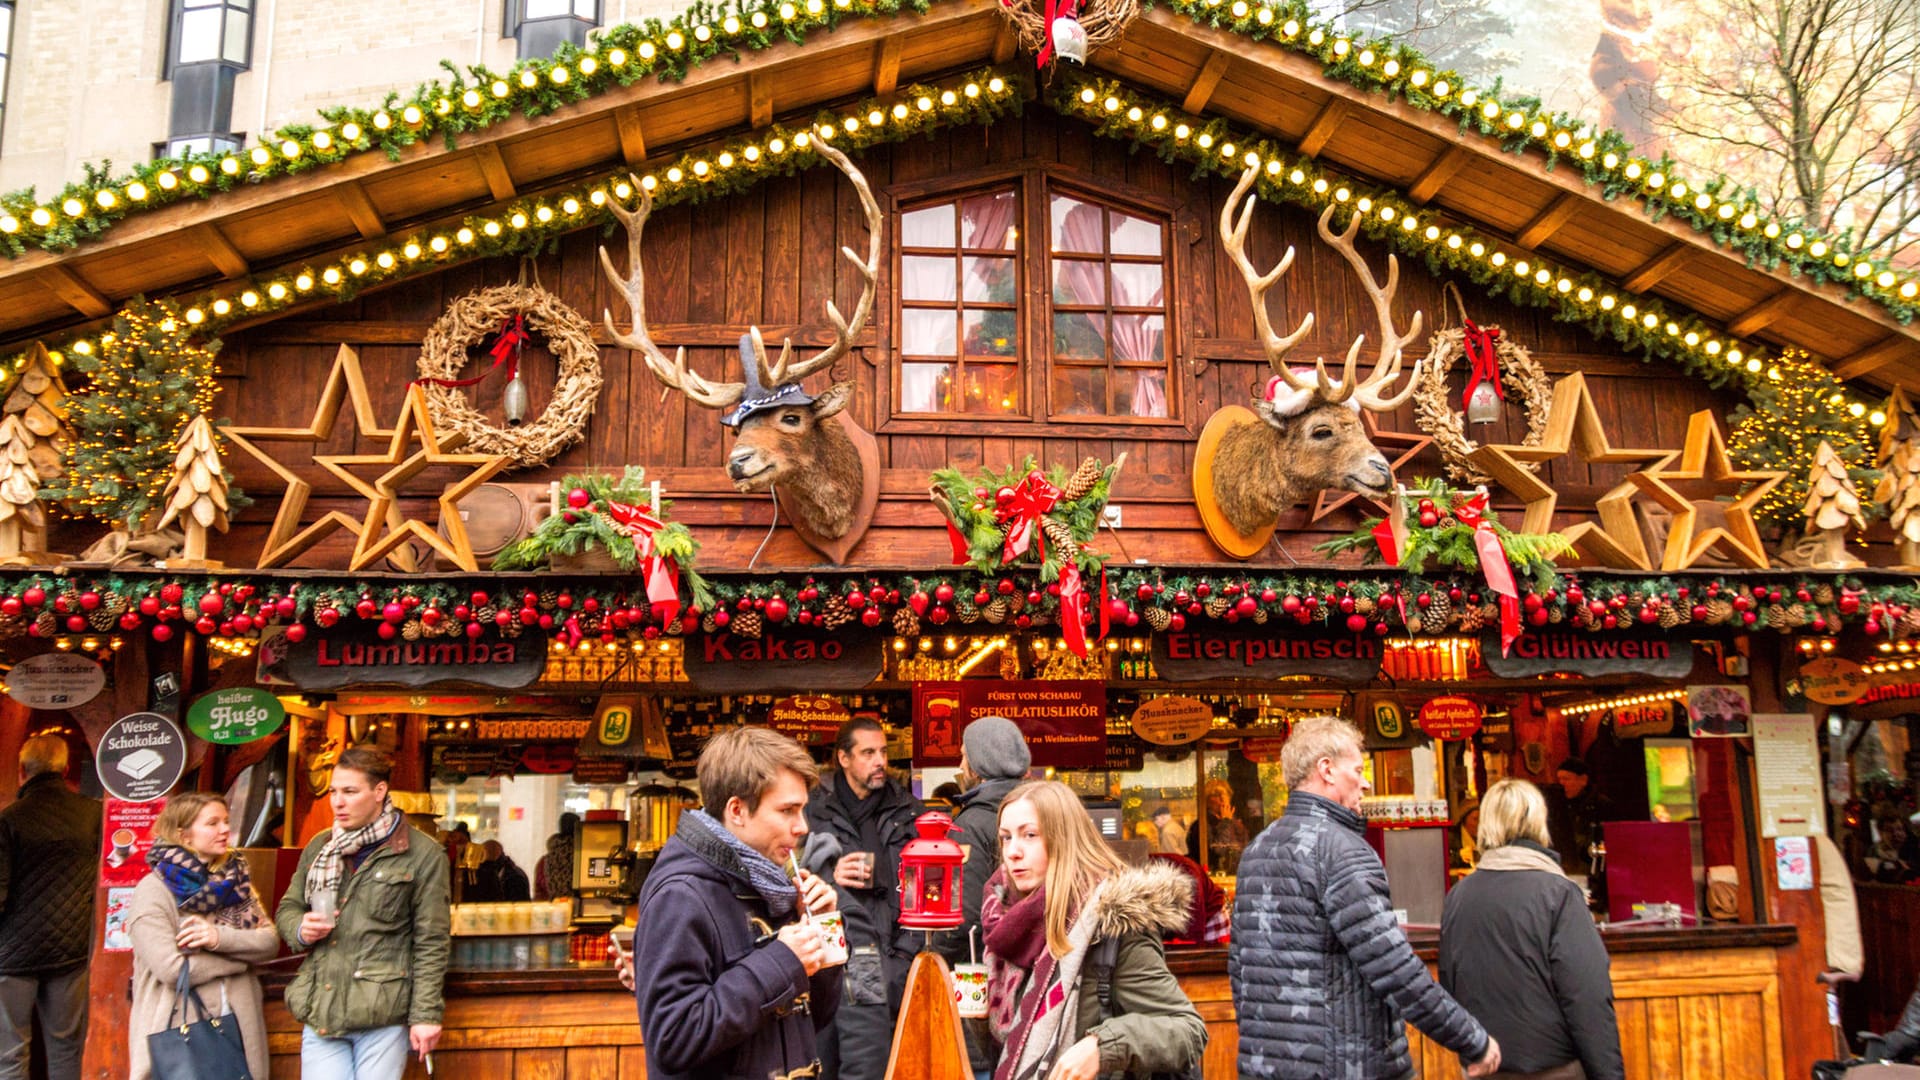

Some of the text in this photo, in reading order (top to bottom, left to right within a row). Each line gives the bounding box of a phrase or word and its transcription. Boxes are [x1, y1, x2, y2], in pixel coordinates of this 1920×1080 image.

[317, 639, 515, 666] Lumumba
[704, 633, 842, 662] Kakao
[1168, 633, 1375, 666] Eierpunsch
[1515, 633, 1670, 659] Glühwein
[217, 693, 253, 704] heißer
[988, 691, 1082, 701] FÜRST VON SCHABAU
[209, 706, 268, 730] Hugo
[970, 703, 1099, 718] SPEKULATIUSLIKÖR
[1617, 707, 1665, 727] Kaffee
[121, 720, 159, 734] Weisse
[108, 732, 172, 750] Schokolade
